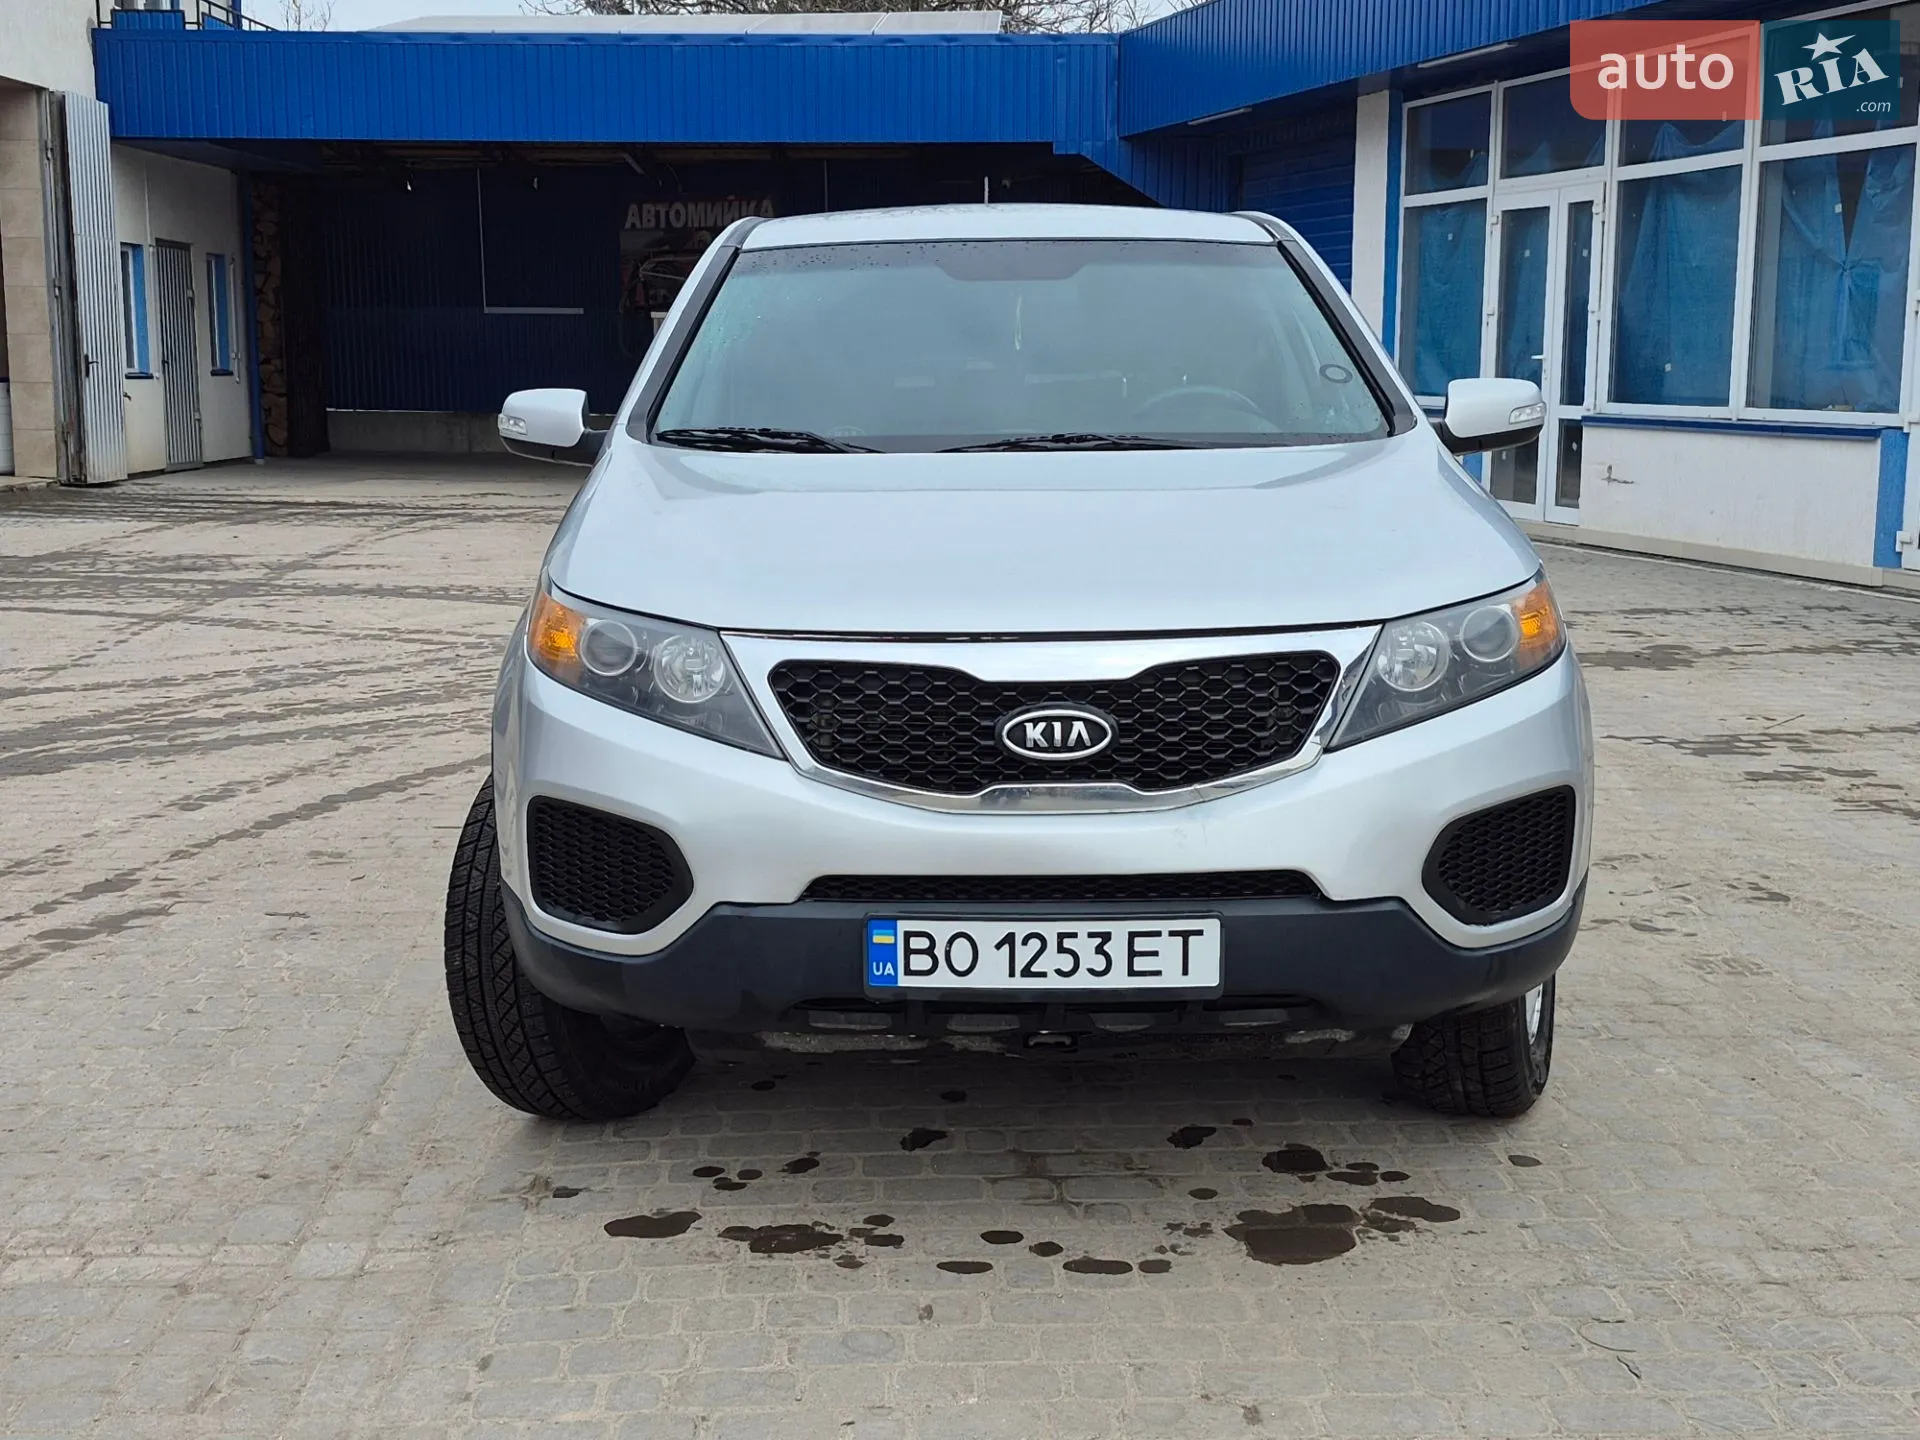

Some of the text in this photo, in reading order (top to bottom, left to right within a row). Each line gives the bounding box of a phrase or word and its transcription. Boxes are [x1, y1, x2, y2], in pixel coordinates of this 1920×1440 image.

[1024, 721, 1091, 748] KIA
[903, 929, 1205, 978] BO 1253 ET
[873, 962, 894, 976] UA
